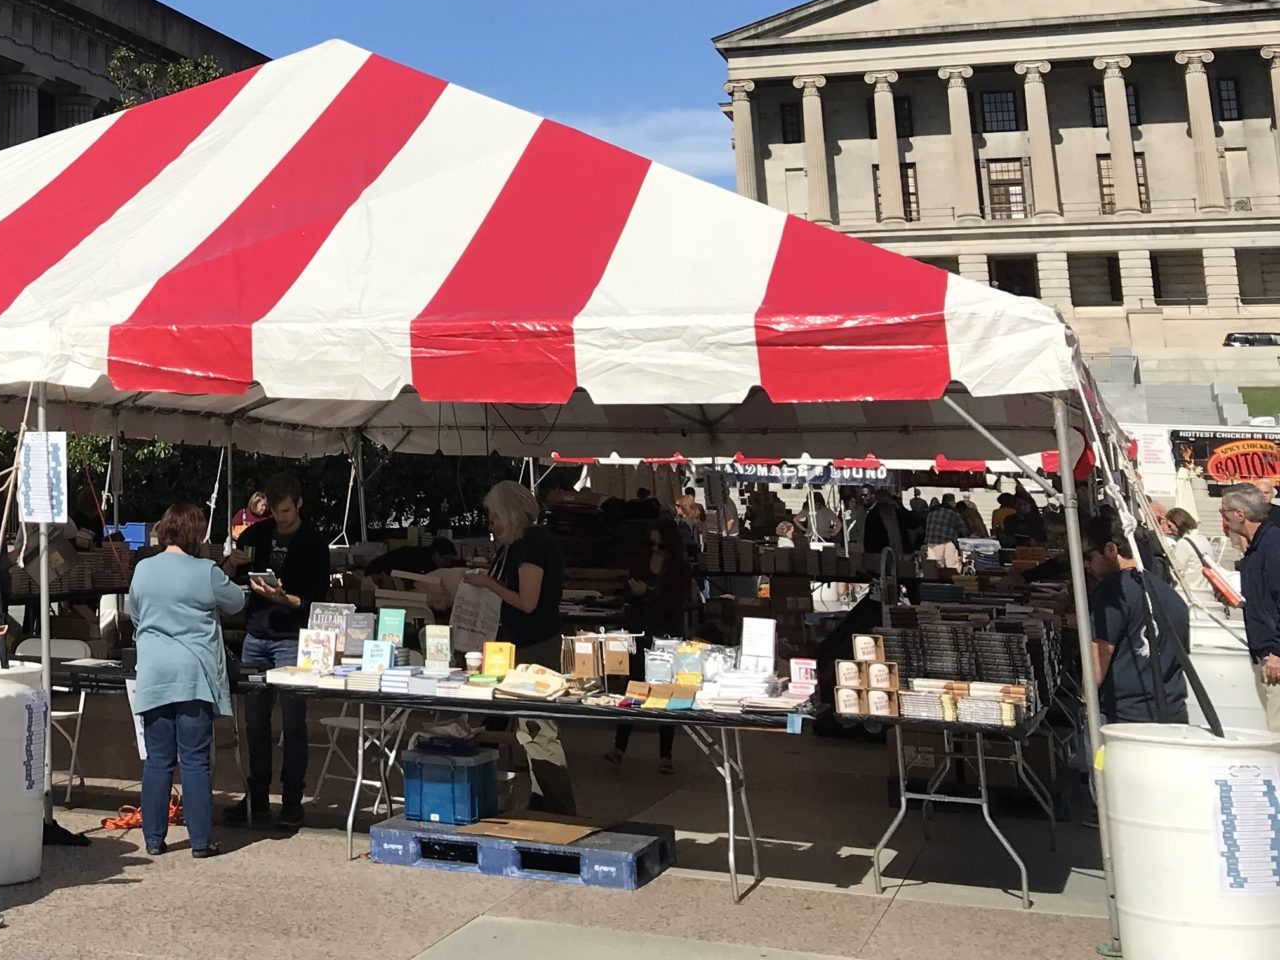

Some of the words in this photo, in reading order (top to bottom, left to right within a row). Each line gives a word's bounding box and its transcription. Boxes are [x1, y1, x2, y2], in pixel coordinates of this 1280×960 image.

[1221, 445, 1241, 455] SPICY
[1242, 443, 1274, 451] CHICKEN
[715, 464, 808, 477] ANDMADE
